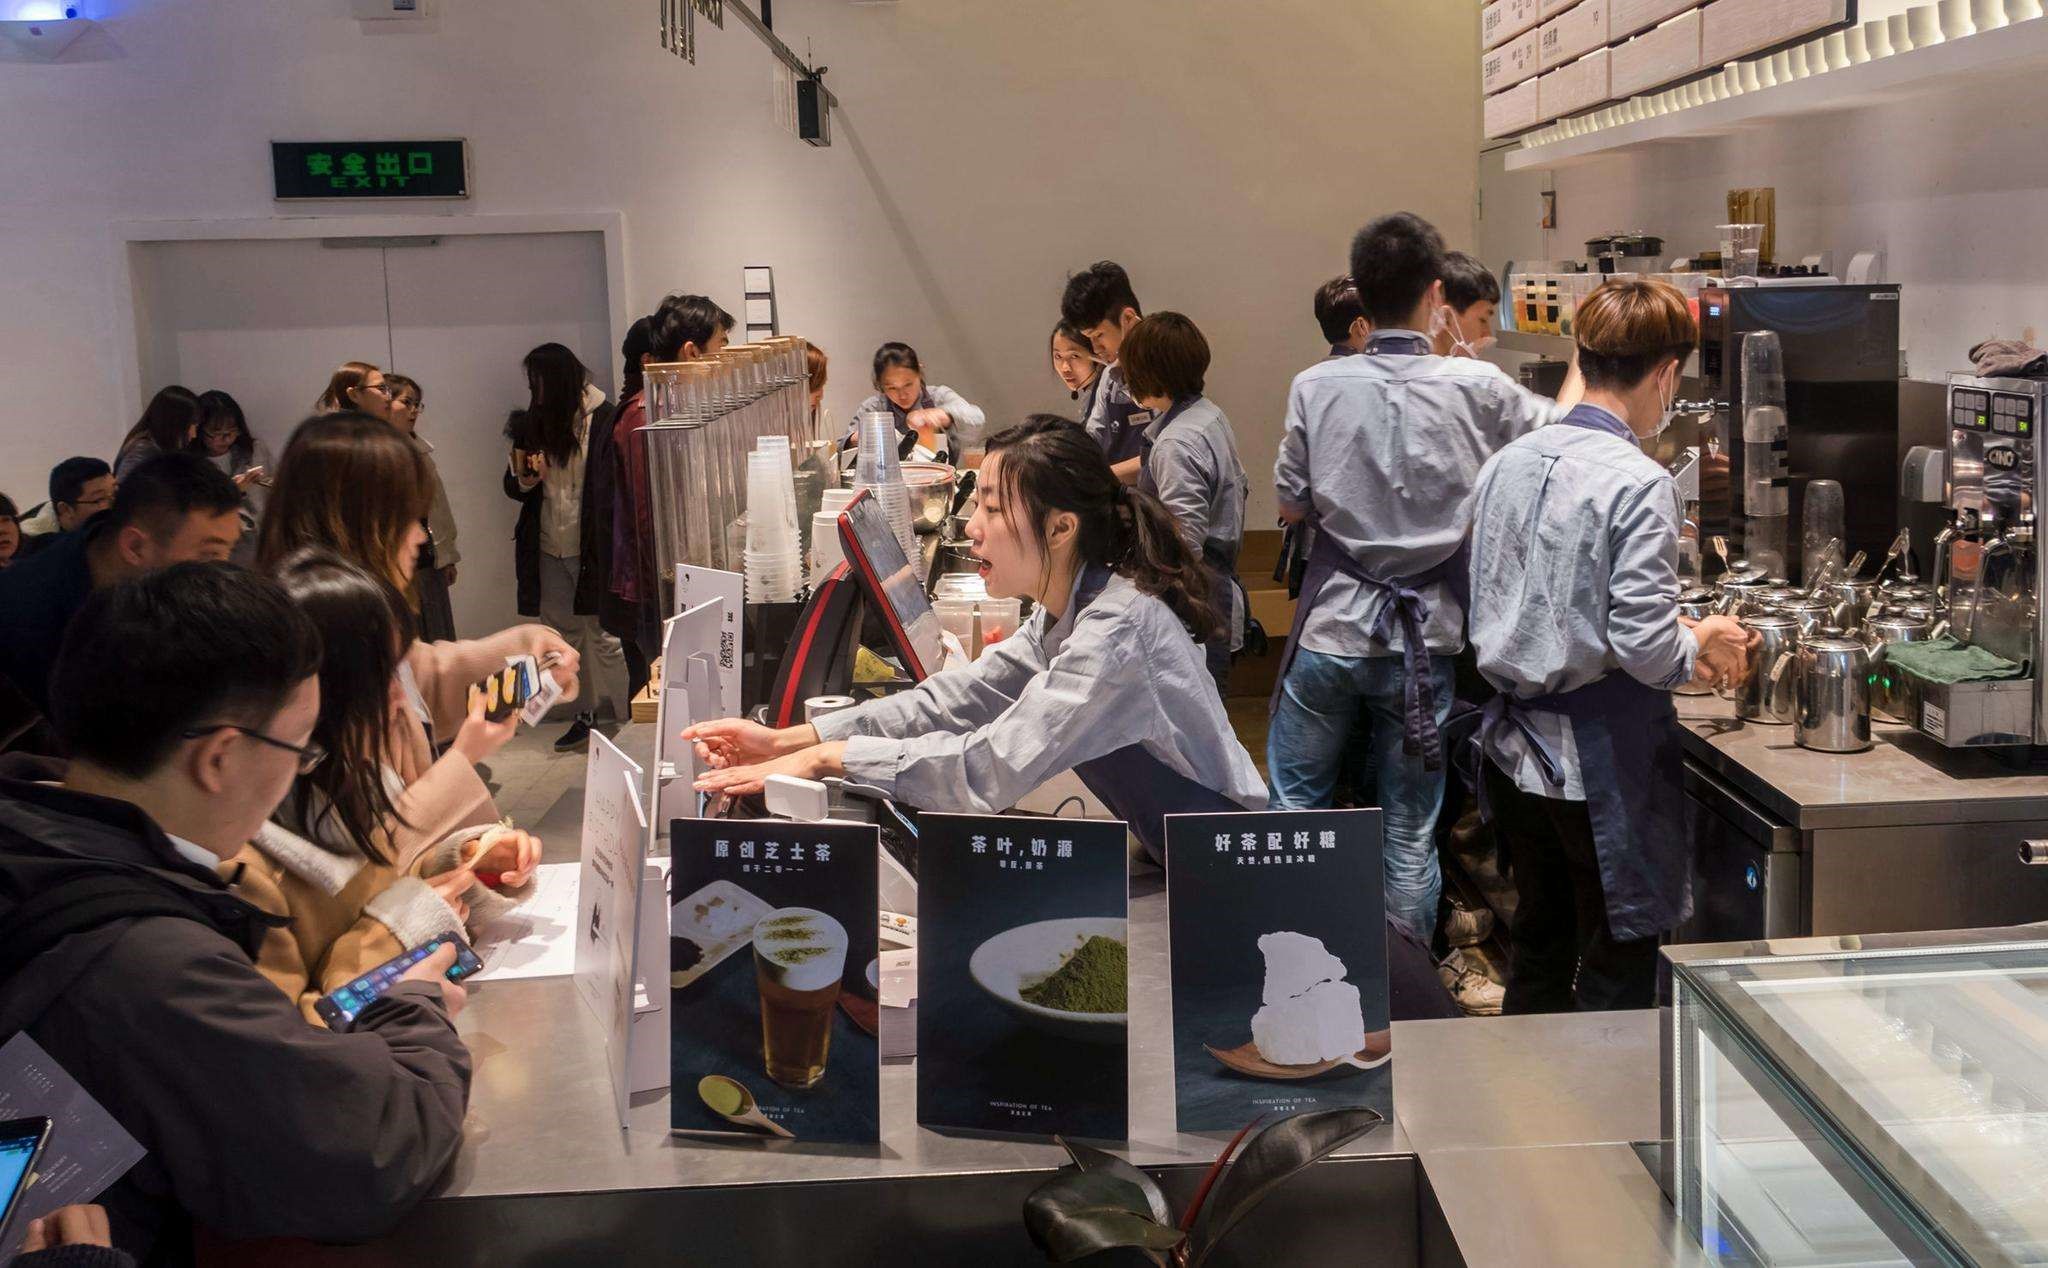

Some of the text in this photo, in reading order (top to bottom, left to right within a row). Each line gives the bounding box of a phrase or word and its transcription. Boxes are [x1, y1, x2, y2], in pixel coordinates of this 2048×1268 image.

[306, 152, 433, 175] 安全出口
[329, 176, 411, 188] EXIT
[714, 839, 831, 862] 原创芝士茶
[971, 835, 1073, 858] 茶叶,奶源
[1214, 830, 1336, 852] 好茶配好糖
